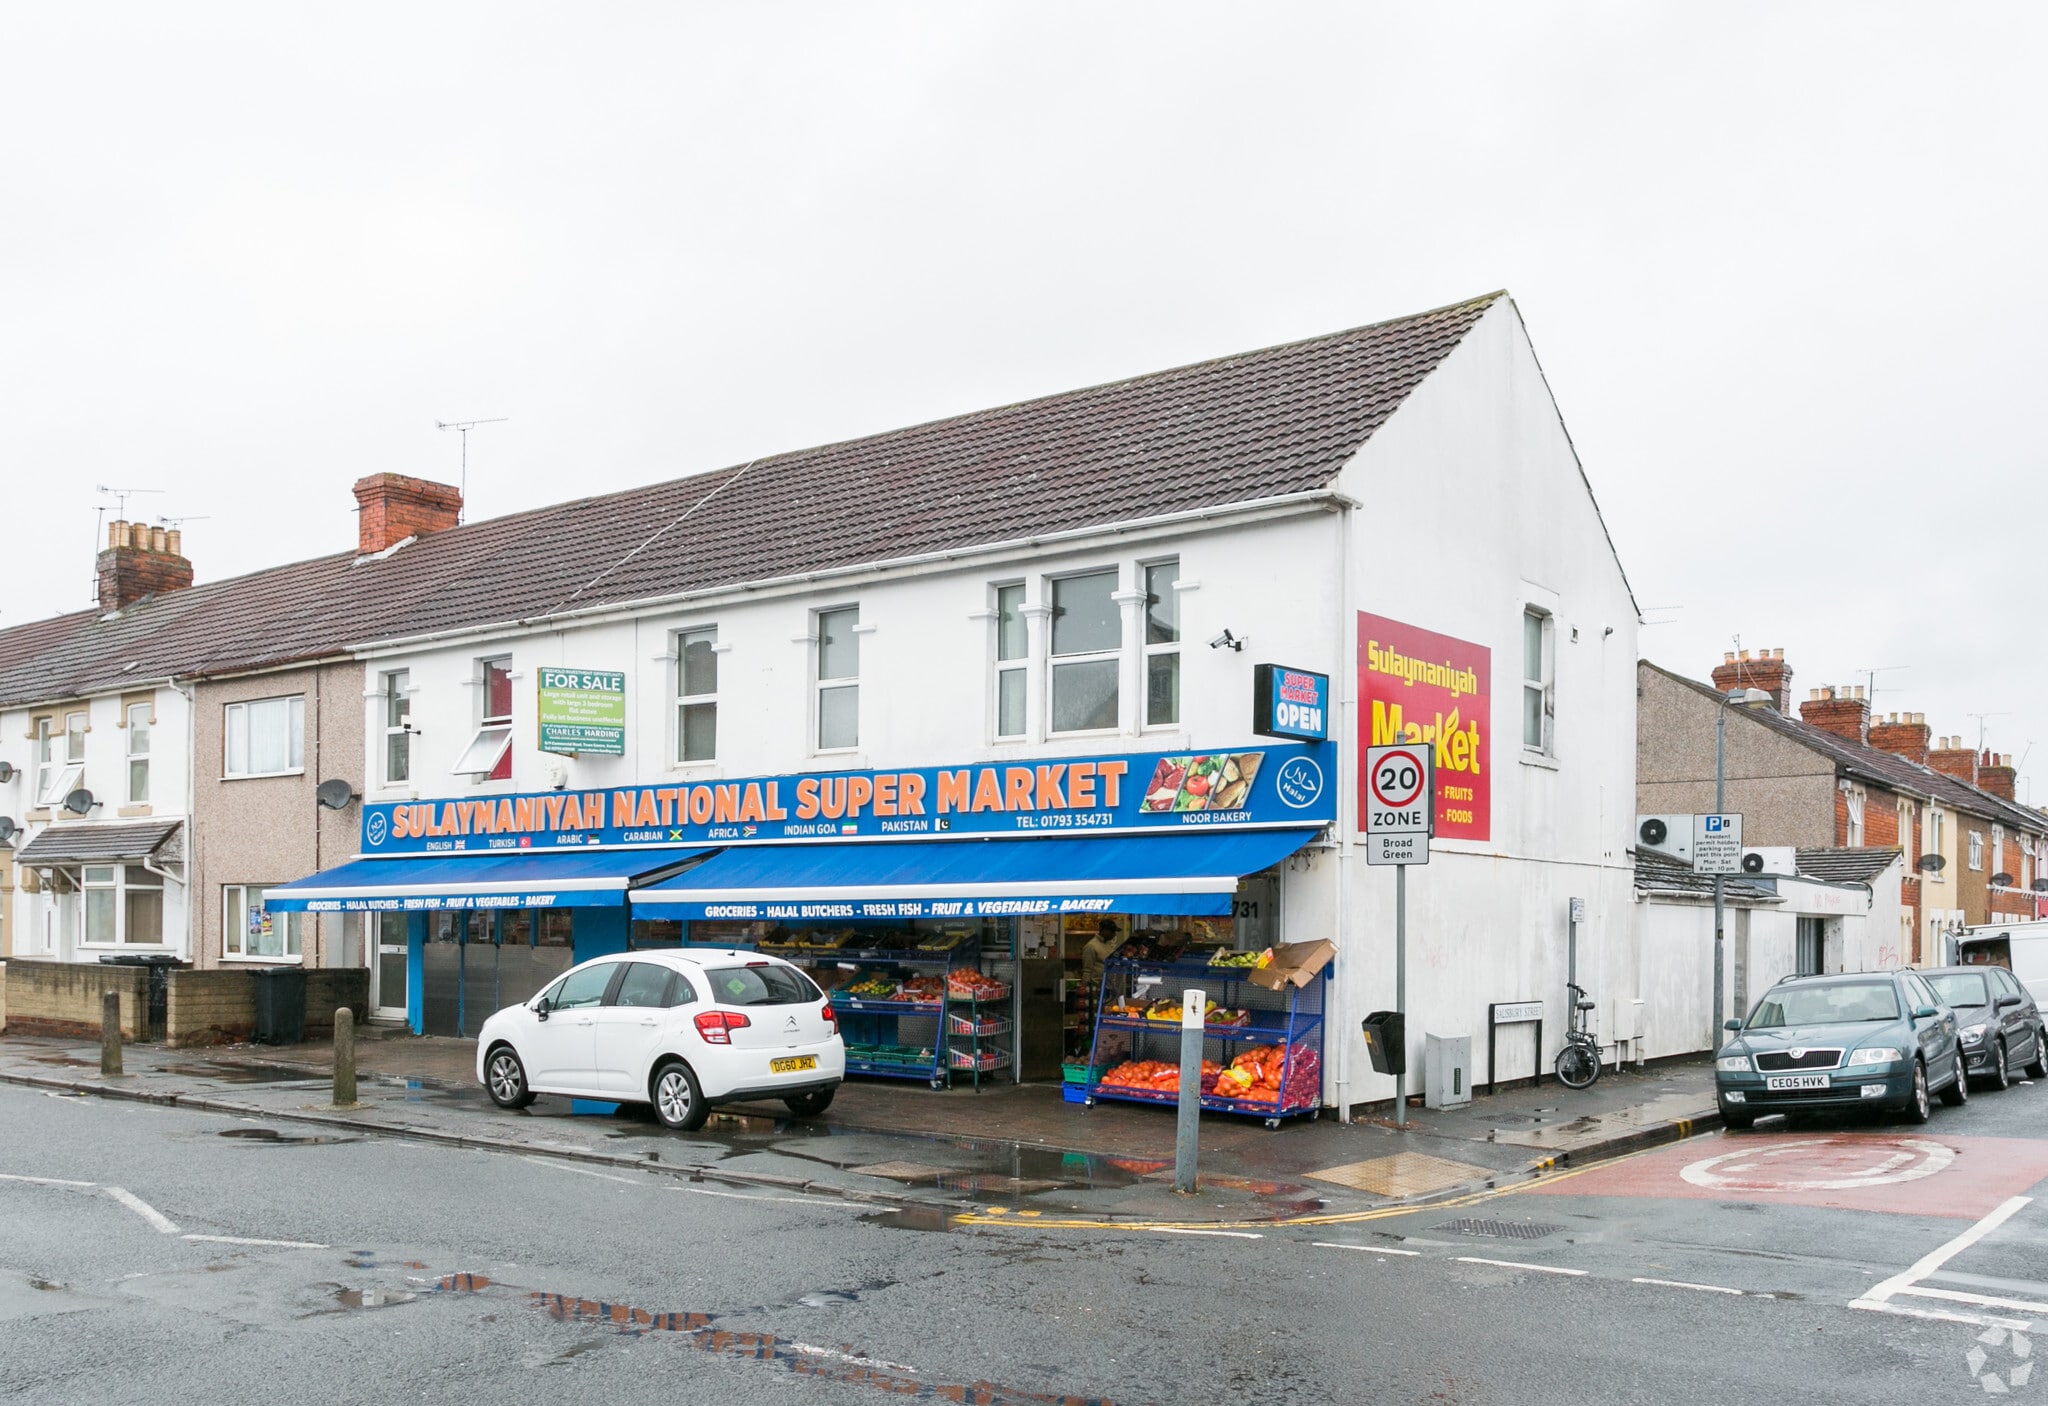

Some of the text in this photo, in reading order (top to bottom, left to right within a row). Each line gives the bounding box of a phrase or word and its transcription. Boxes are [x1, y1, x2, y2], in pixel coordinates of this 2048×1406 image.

[1368, 640, 1477, 698] Sulaymaniyah
[546, 673, 621, 691] FOR SALE
[1284, 671, 1315, 690] SUPER
[1280, 686, 1318, 705] MARKET
[1276, 702, 1322, 732] OPEN
[547, 728, 620, 738] CHARLES HARDING
[1284, 766, 1317, 792] حلال
[1381, 767, 1417, 790] 20
[391, 792, 606, 839] SULAYMANIYAH
[612, 781, 787, 828] NATIONAL
[795, 773, 927, 820] SUPER
[936, 760, 1129, 815] MARKET
[1282, 782, 1306, 803] Halal
[1444, 785, 1473, 801] FRUITS
[1016, 813, 1113, 828] TEL: 01793 354731
[1182, 811, 1252, 824] NOOR BAKERY
[1373, 811, 1421, 826] ZONE
[1446, 808, 1473, 824] FOODS
[784, 824, 837, 836] INDIAN GOA
[881, 820, 928, 832] PAKISTAN
[1710, 817, 1720, 831] P
[556, 834, 583, 845] ARABIC
[623, 831, 663, 842] CARABIAN
[708, 828, 739, 839] AFRICA
[426, 841, 452, 851] ENGLISH
[488, 838, 516, 849] TURKISH
[1383, 838, 1413, 848] Broad
[1382, 850, 1413, 859] Green
[307, 900, 342, 911] GROCERIES
[346, 900, 368, 911] HALAL
[368, 899, 399, 910] BUTCHERS
[404, 898, 424, 909] FRESH
[424, 898, 441, 908] FISH
[446, 897, 467, 908] FRUIT
[467, 897, 474, 907] &
[475, 896, 520, 907] VEGETABLES
[525, 895, 557, 906] BAKERY
[705, 905, 758, 918] GROCERIES
[766, 905, 799, 917] HALAL
[801, 904, 854, 917] BUTCHERS
[863, 903, 896, 916] FRESH
[898, 903, 922, 916] FISH
[931, 902, 963, 915] FRUIT
[964, 902, 974, 914] &
[977, 900, 1050, 914] VEGETABLES
[1060, 899, 1114, 911] BAKERY
[774, 1058, 813, 1072] DG60 JHZ
[1771, 1076, 1824, 1088] CE05 HVK
